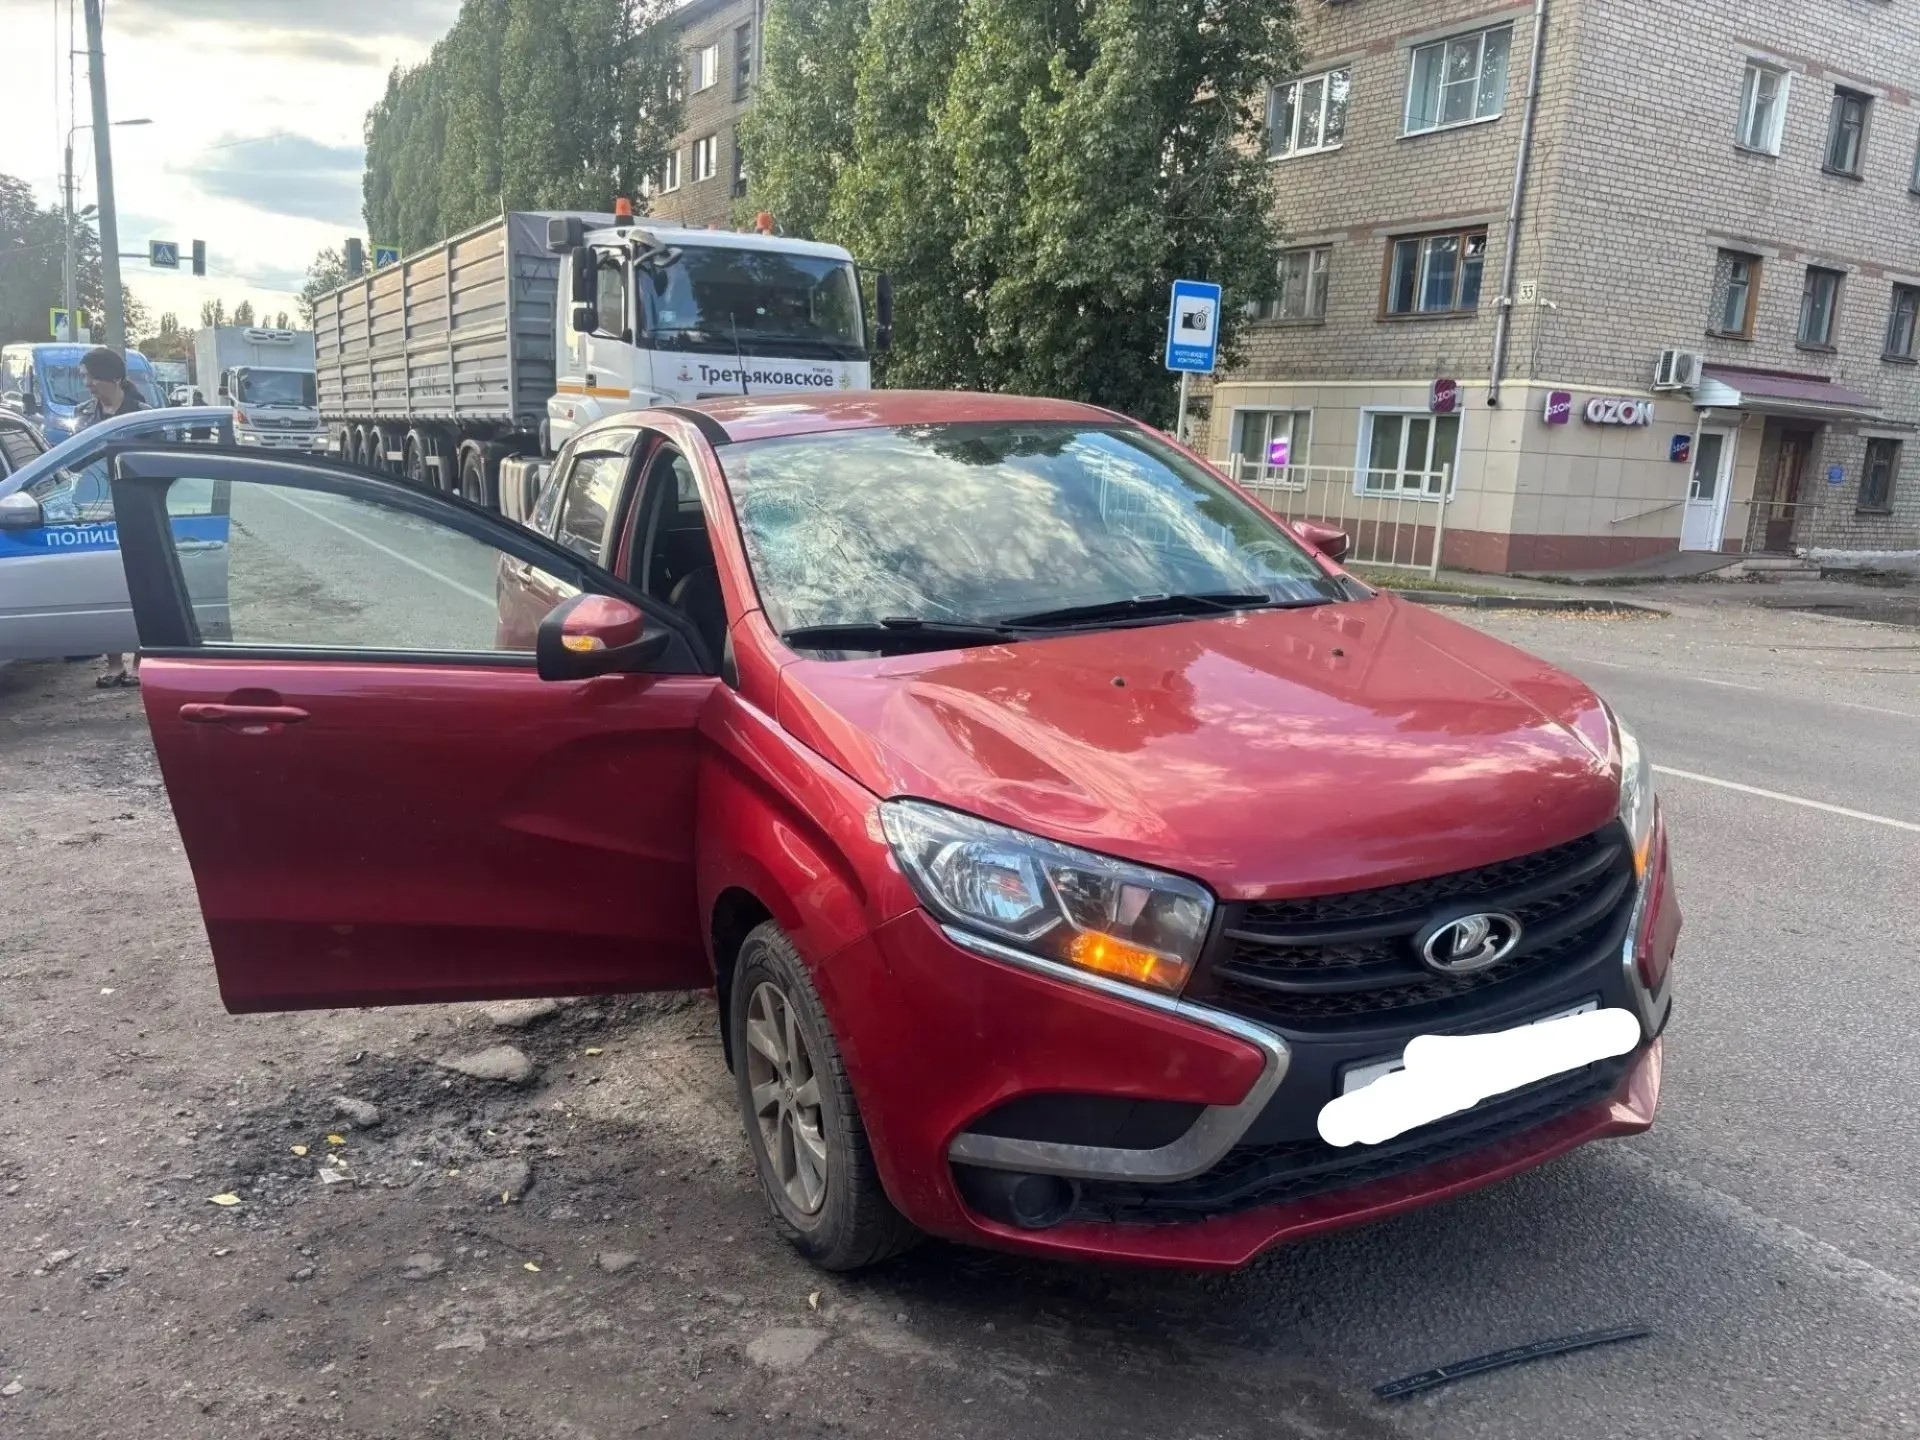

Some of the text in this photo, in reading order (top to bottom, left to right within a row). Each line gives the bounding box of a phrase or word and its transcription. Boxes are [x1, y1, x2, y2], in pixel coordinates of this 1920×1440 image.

[1522, 285, 1534, 300] 33
[698, 364, 834, 387] Третьяковское
[1546, 402, 1571, 416] OZON
[1586, 399, 1655, 425] OZON
[46, 529, 120, 546] ПОЛИЦ
